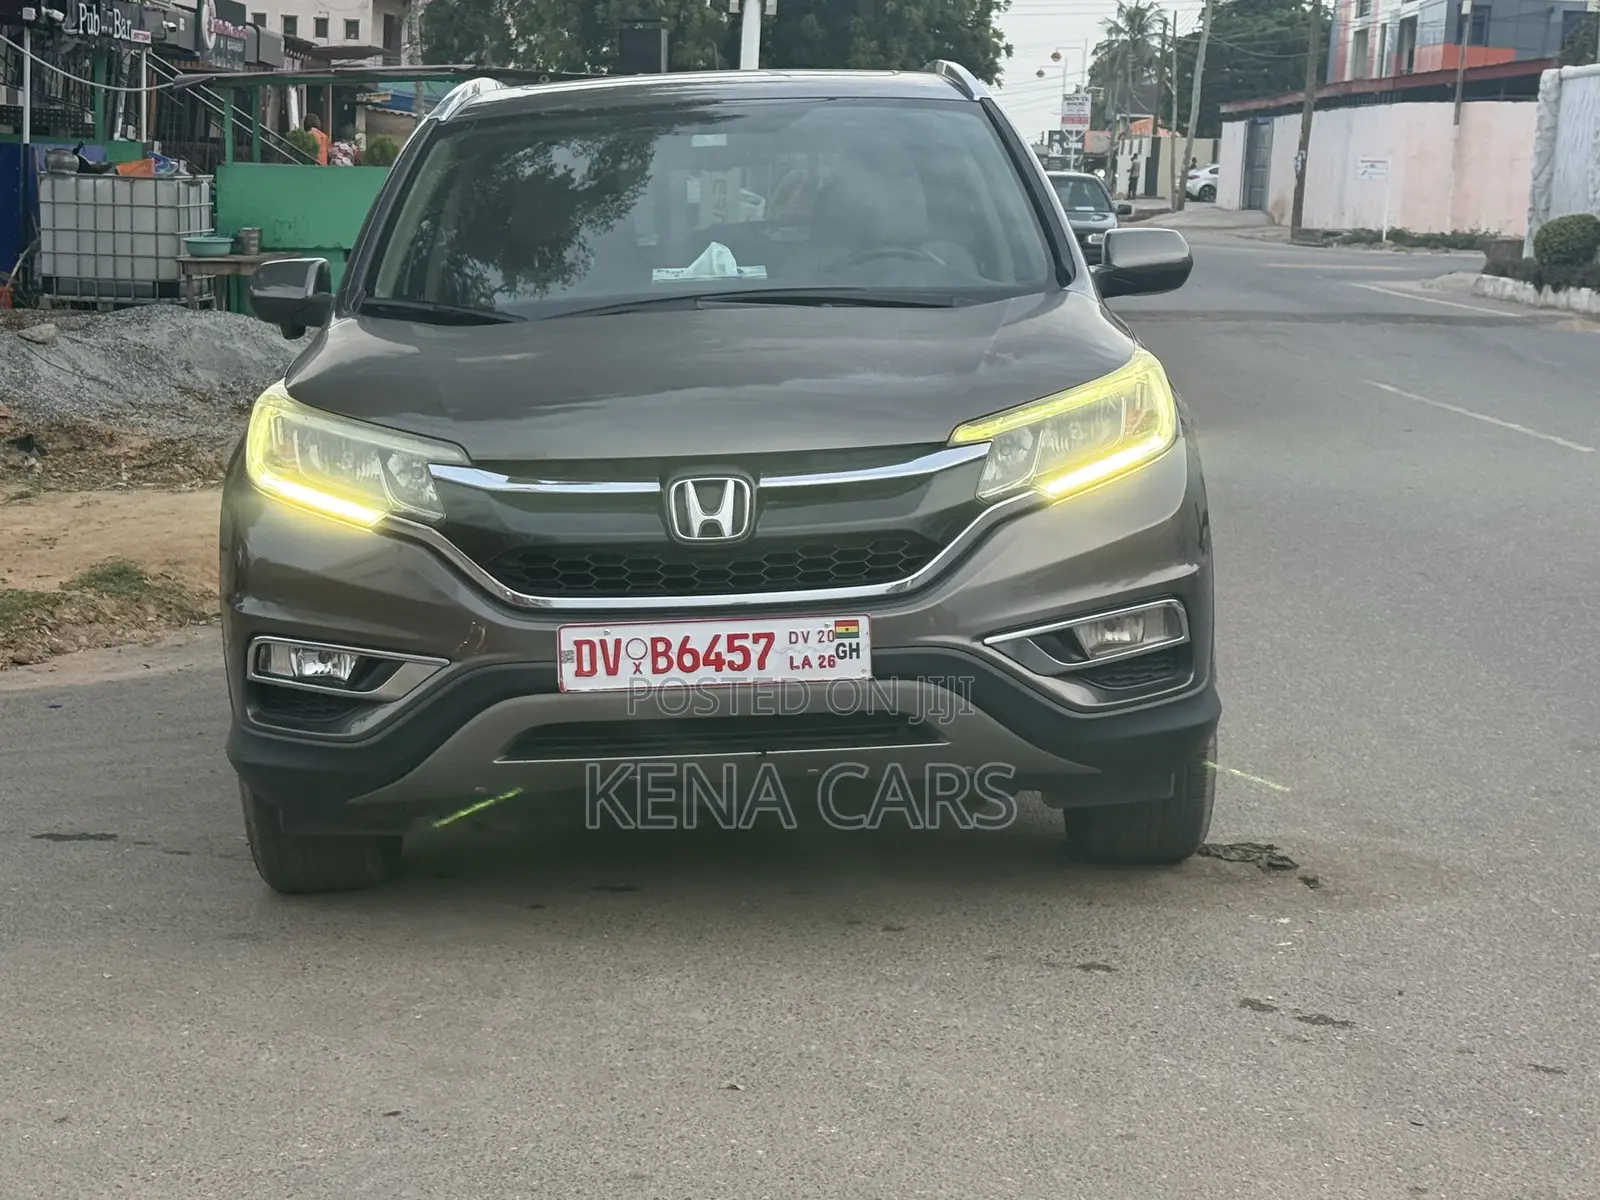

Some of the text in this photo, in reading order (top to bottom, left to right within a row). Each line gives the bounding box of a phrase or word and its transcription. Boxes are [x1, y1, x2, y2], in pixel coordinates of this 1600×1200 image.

[79, 3, 100, 36] Pub
[113, 8, 132, 40] Bar
[788, 629, 835, 645] DV 20
[573, 632, 776, 677] DV B6457
[835, 642, 861, 660] GH
[789, 654, 837, 670] LA 26
